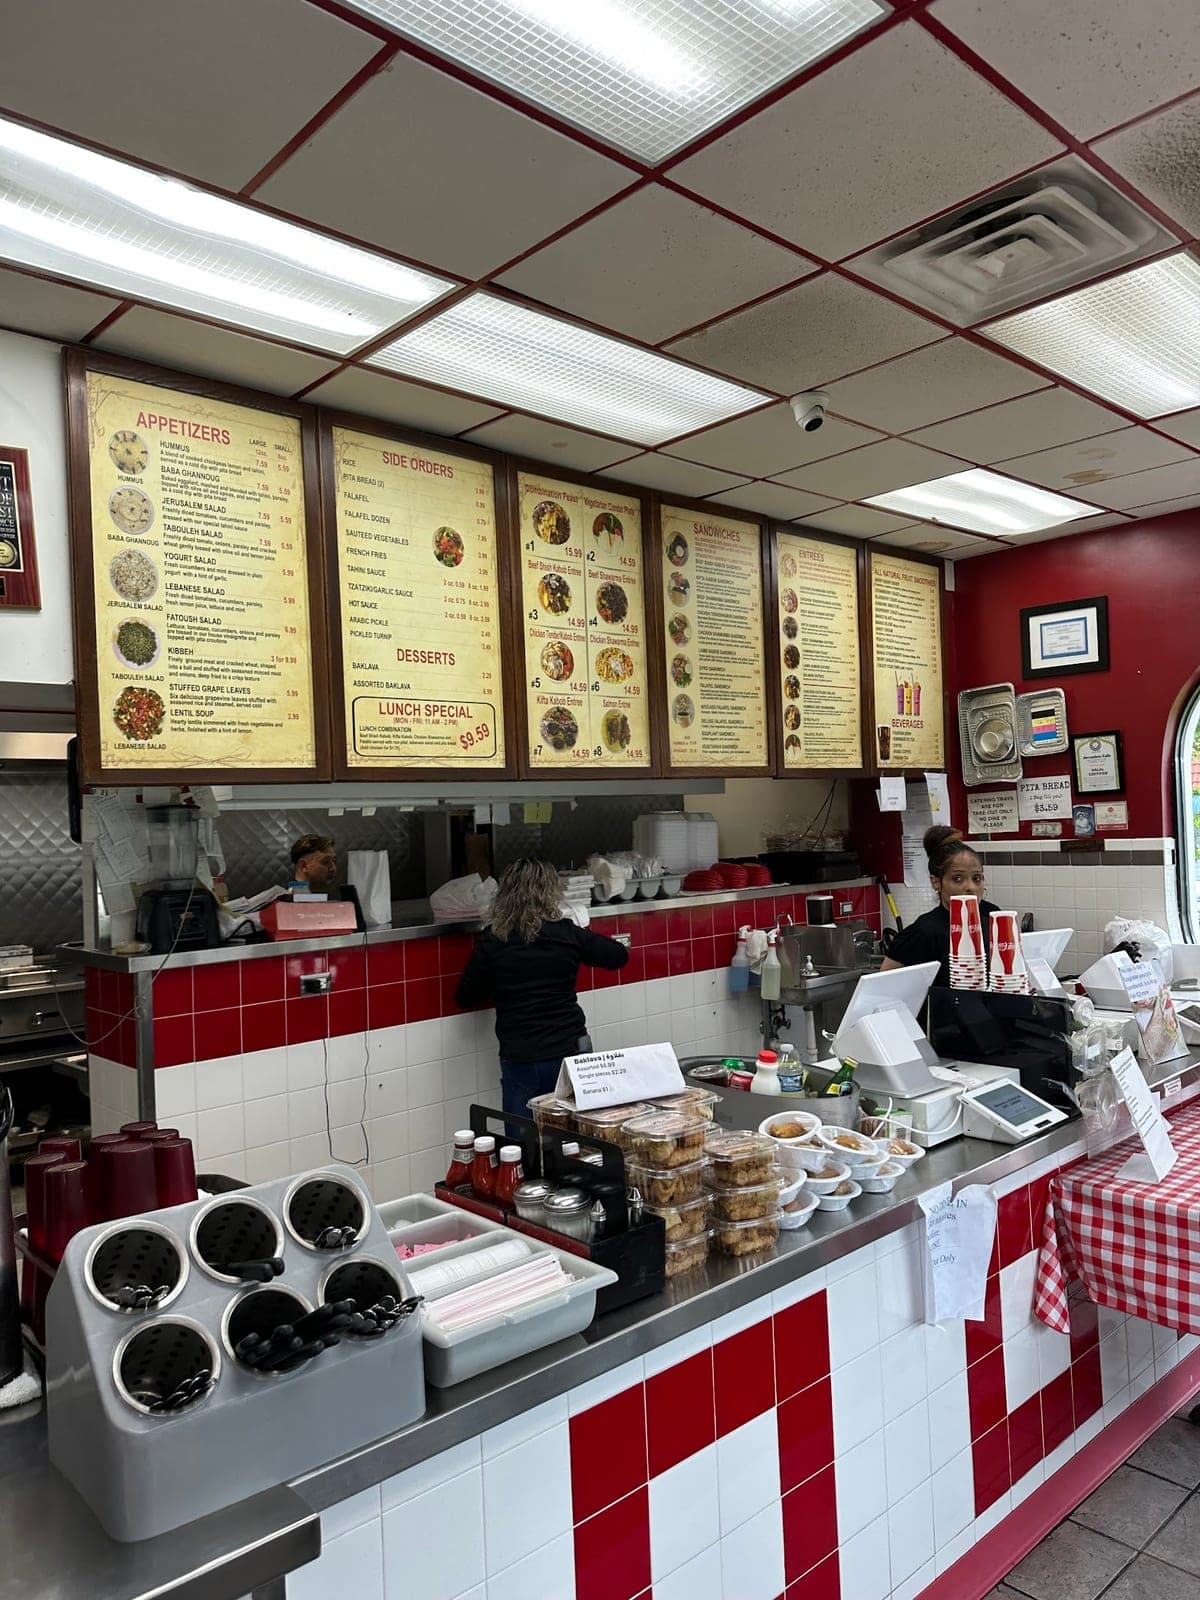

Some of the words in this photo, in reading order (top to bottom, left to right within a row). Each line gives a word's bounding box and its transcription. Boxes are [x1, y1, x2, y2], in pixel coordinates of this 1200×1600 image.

[136, 412, 230, 445] APPETIZERS
[159, 440, 189, 452] HUMMUS
[248, 438, 266, 448] LARGE
[274, 443, 290, 452] SMALL
[342, 458, 355, 467] RICE
[383, 451, 407, 468] SIDE
[411, 458, 453, 478] ORDERS
[117, 474, 143, 484] HUMMUS
[160, 465, 180, 476] BABA
[182, 469, 219, 482] GHANNOUG
[343, 473, 355, 481] PITA
[356, 476, 376, 485] BREAD
[344, 491, 368, 502] FALAFEL
[525, 484, 560, 499] Combination
[161, 496, 202, 510] JERUSALEM
[204, 503, 226, 513] SALAD
[344, 509, 369, 520] FALAFEL
[370, 514, 389, 524] DOZEN
[163, 524, 199, 536] TABOULEH
[200, 529, 223, 539] SALAD
[345, 528, 372, 539] SAUTEED
[373, 533, 408, 546] VEGETABLES
[693, 522, 740, 542] SANDWICHES
[107, 534, 124, 542] BABA
[125, 536, 158, 546] GHANNOUG
[346, 547, 369, 556] FRENCH
[371, 551, 386, 559] FRIES
[526, 539, 534, 551] #1
[565, 546, 582, 558] 15.99
[164, 552, 192, 562] YOGURT
[193, 555, 216, 565] SALAD
[586, 550, 595, 561] #2
[800, 550, 824, 562] ENTREES
[347, 565, 365, 573] TAHINI
[366, 568, 385, 576] SAUCE
[165, 582, 201, 593] LEBANESE
[202, 586, 224, 595] SALAD
[395, 589, 412, 597] SAUCE
[106, 600, 142, 609] JERUSALEM
[361, 601, 377, 609] SAUCE
[166, 613, 198, 623] FATOUSH
[200, 616, 221, 625] SALAD
[349, 616, 369, 624] ARABIC
[528, 608, 537, 620] #3
[568, 617, 584, 627] 14.99
[589, 615, 597, 626] #4
[622, 623, 638, 633] 14.99
[350, 630, 372, 638] PICKLED
[167, 647, 193, 655] KIBBEH
[396, 648, 455, 666] DESSERTS
[169, 683, 200, 692] STUFFED
[352, 680, 384, 688] ASSORTED
[531, 677, 540, 688] #5
[570, 682, 586, 691] 14.59
[591, 681, 599, 691] #6
[624, 685, 640, 695] 14.59
[378, 701, 420, 716] LUNCH
[424, 704, 472, 718] SPECIAL
[892, 719, 924, 728] BEVERAGES
[459, 722, 490, 750] $9.59
[534, 745, 542, 755] #7
[593, 746, 601, 755] #8
[1021, 784, 1040, 792] PITA
[1042, 781, 1069, 790] BREAD
[1035, 803, 1058, 813] $3.59
[957, 1200, 967, 1208] IN
[940, 1254, 956, 1264] Only
